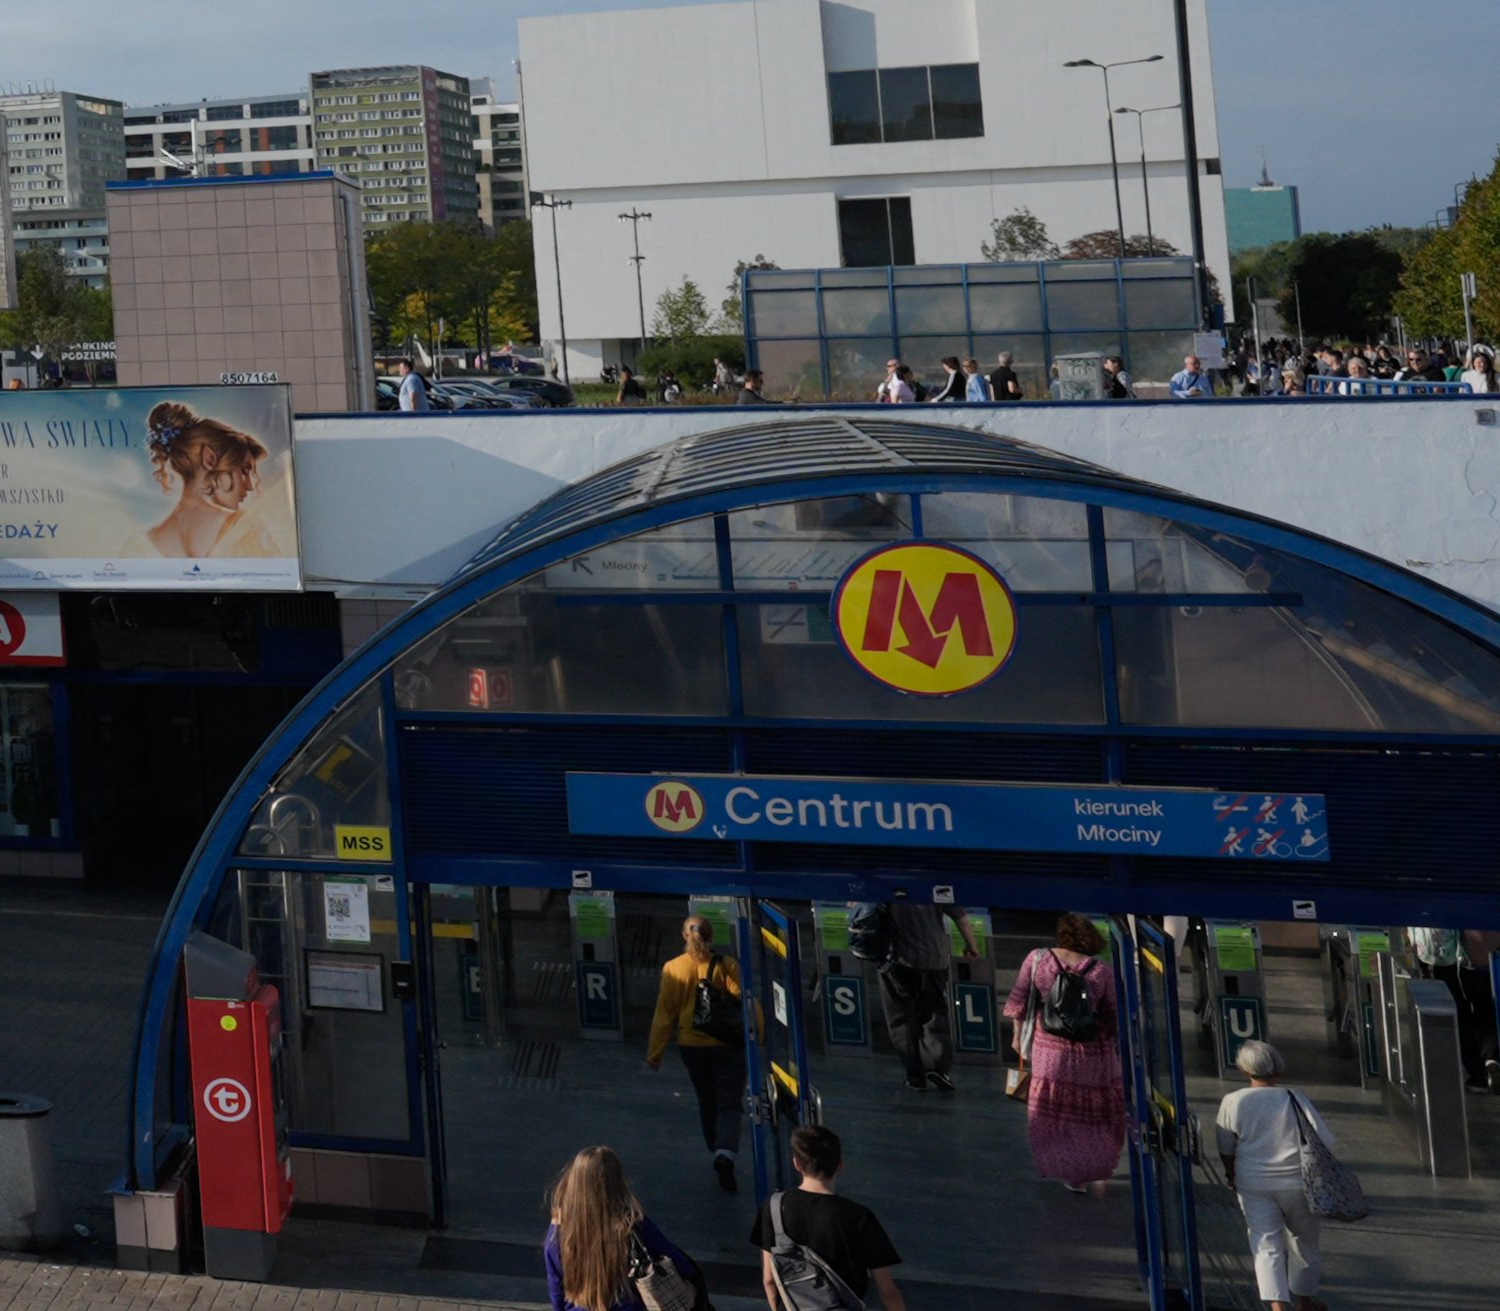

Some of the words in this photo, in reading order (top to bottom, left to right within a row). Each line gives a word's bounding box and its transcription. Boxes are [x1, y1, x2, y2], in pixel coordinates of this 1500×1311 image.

[222, 373, 276, 384] 8507164
[47, 414, 138, 449] ŚWIATY.
[861, 569, 994, 669] M
[653, 789, 696, 823] M
[724, 786, 954, 832] Centrum
[1074, 797, 1164, 817] kierunek
[342, 835, 384, 851] MSS
[1077, 824, 1162, 846] Młociny
[586, 972, 608, 1001] R
[834, 986, 856, 1016] S
[965, 994, 984, 1023] L
[1229, 1007, 1255, 1038] U
